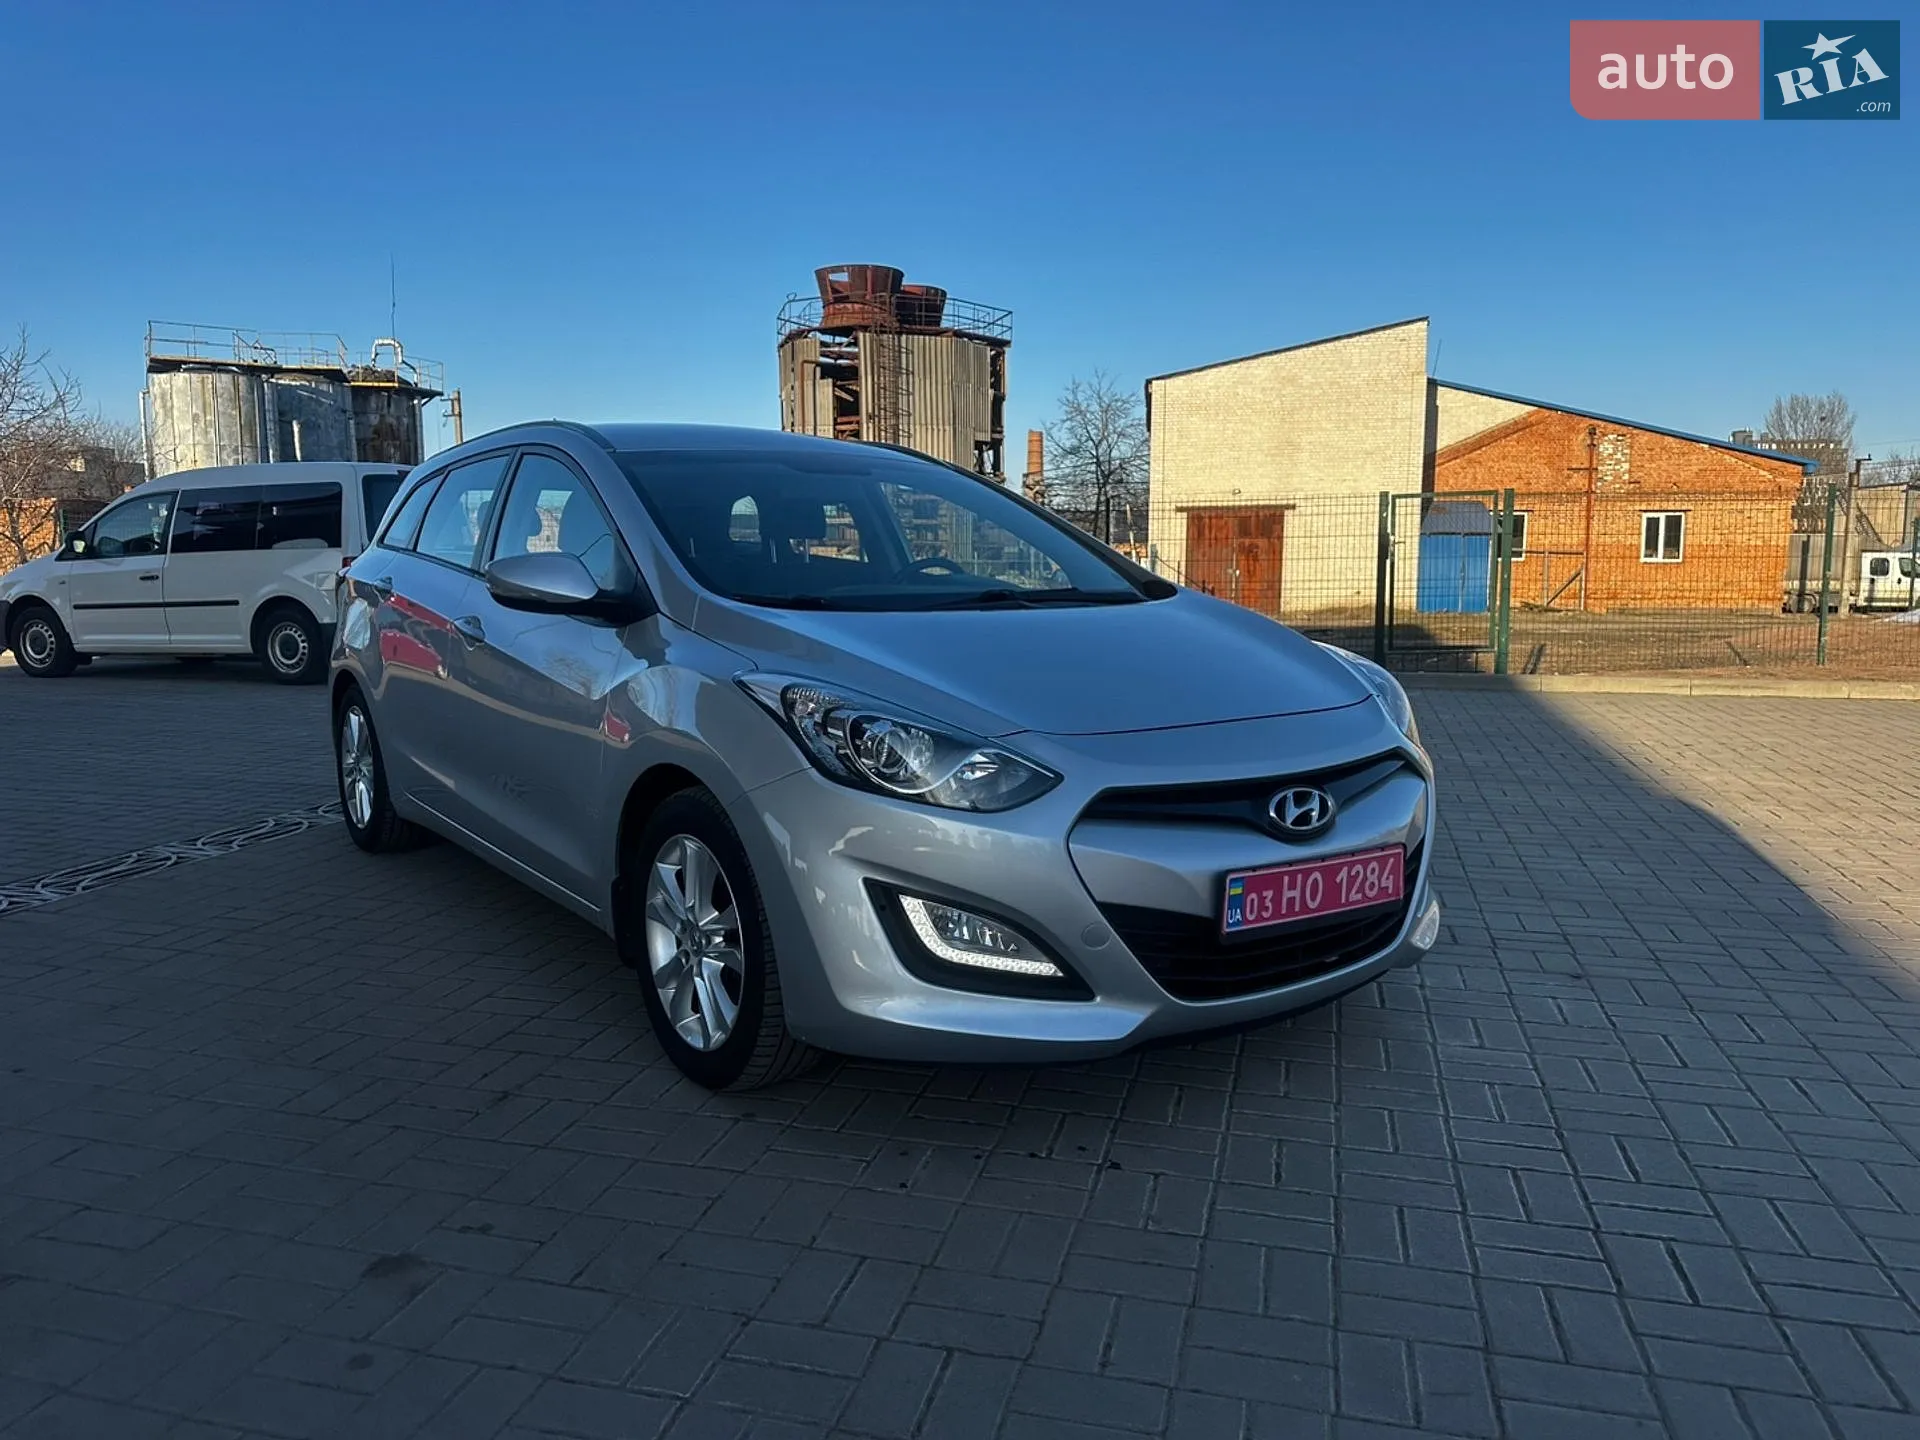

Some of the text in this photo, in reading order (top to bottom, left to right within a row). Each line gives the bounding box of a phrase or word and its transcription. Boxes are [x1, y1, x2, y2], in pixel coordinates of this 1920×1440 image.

[1245, 857, 1395, 921] 03 HO 1284
[1227, 908, 1242, 924] UA
